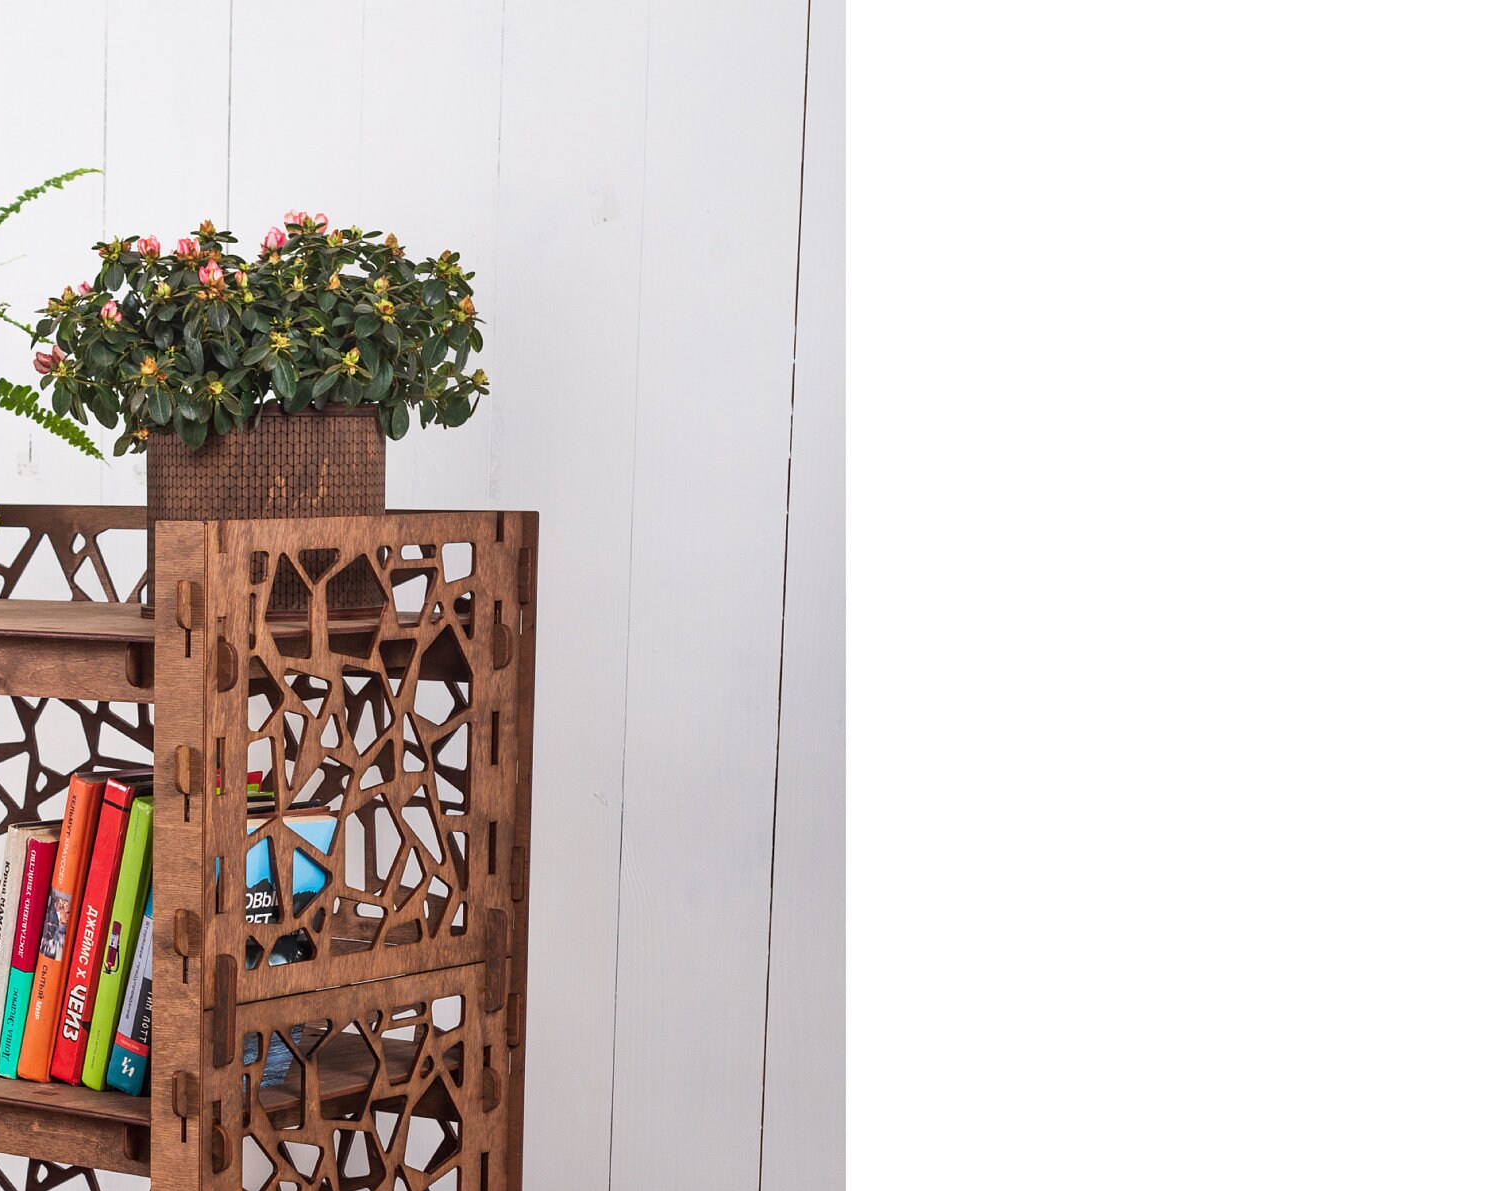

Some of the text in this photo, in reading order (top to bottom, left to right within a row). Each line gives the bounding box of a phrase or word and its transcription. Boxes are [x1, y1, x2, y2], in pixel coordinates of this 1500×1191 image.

[66, 794, 77, 838] ХЕЛЬМУТ
[1, 861, 11, 895] Юрий
[26, 849, 37, 896] УБИЙСТВО
[78, 904, 99, 965] ДЖЕЙМС
[34, 964, 49, 1020] СЫТЫЙ МИР
